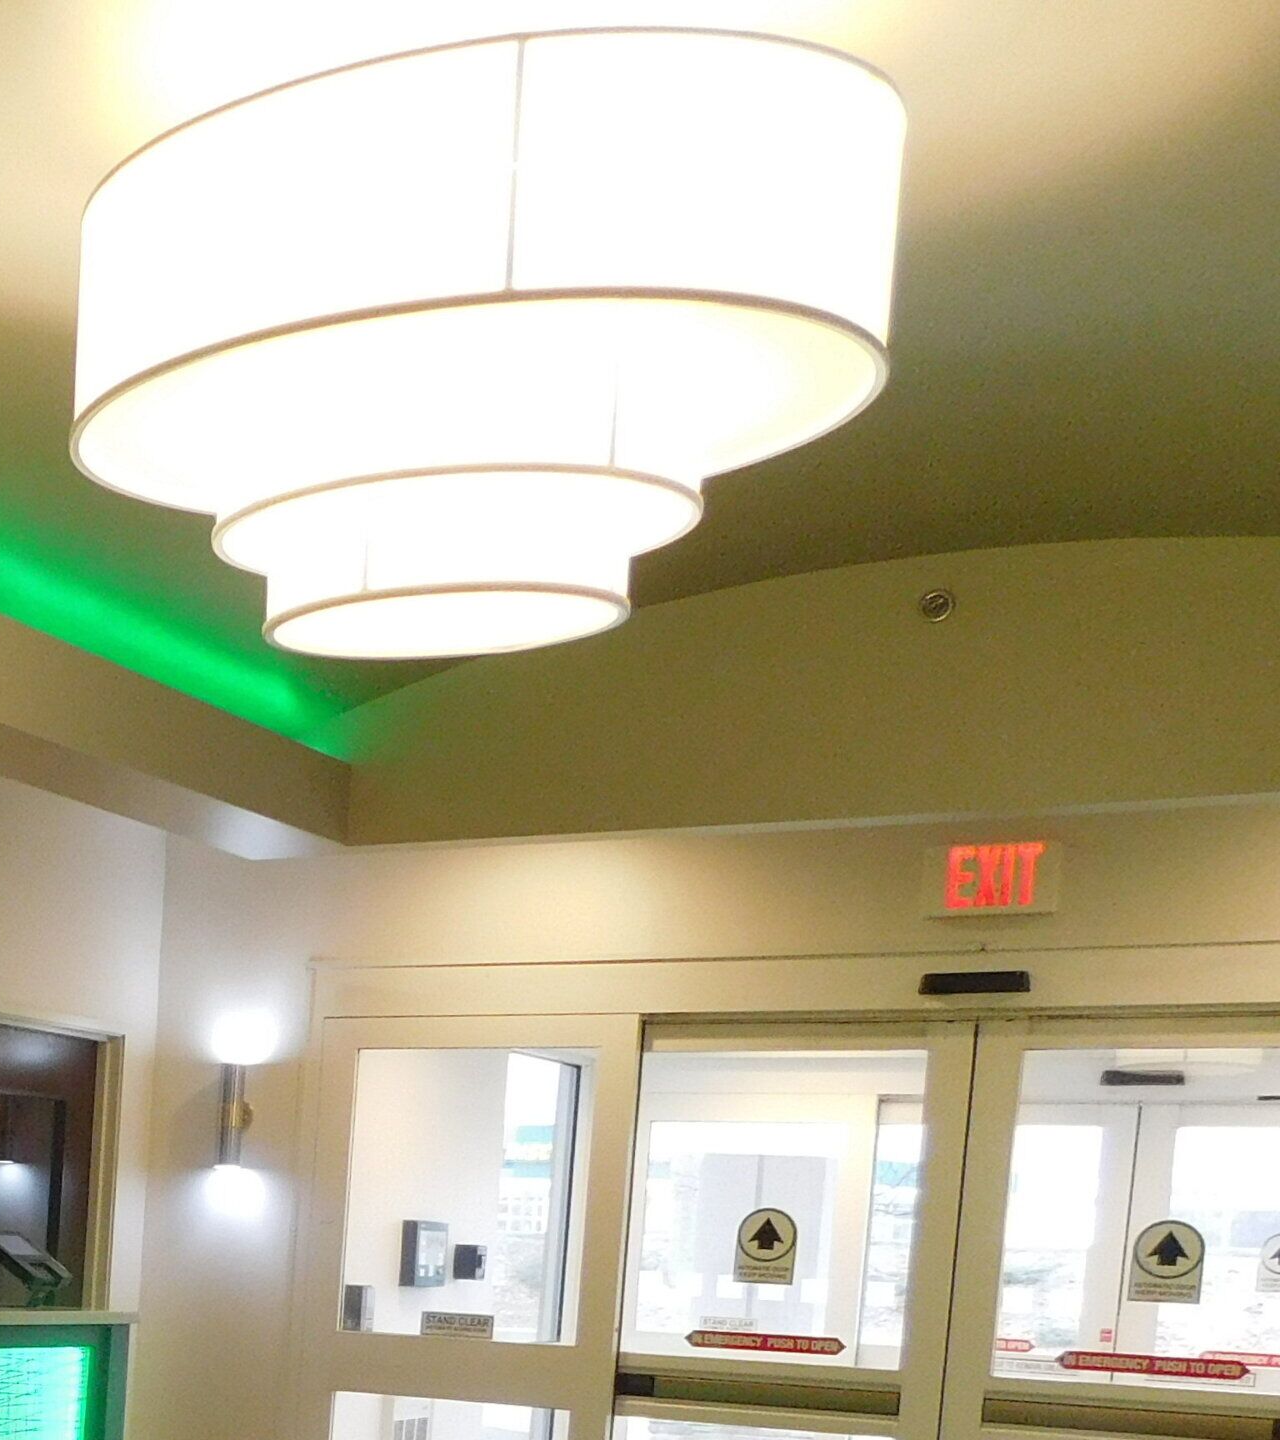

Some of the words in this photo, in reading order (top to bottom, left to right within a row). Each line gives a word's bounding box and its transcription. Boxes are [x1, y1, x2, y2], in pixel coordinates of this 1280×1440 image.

[944, 842, 1047, 909] EXIT
[425, 1313, 456, 1325] STAND
[458, 1315, 490, 1328] CLEAR
[703, 1333, 763, 1348] EMERGENCY
[767, 1337, 794, 1350] PUSH
[796, 1338, 809, 1351] TO
[811, 1339, 839, 1352] OPEN
[1078, 1354, 1150, 1371] EMERGENCY
[1154, 1359, 1187, 1374] PUSH
[1189, 1361, 1205, 1375] TO
[1207, 1362, 1240, 1377] OPEN
